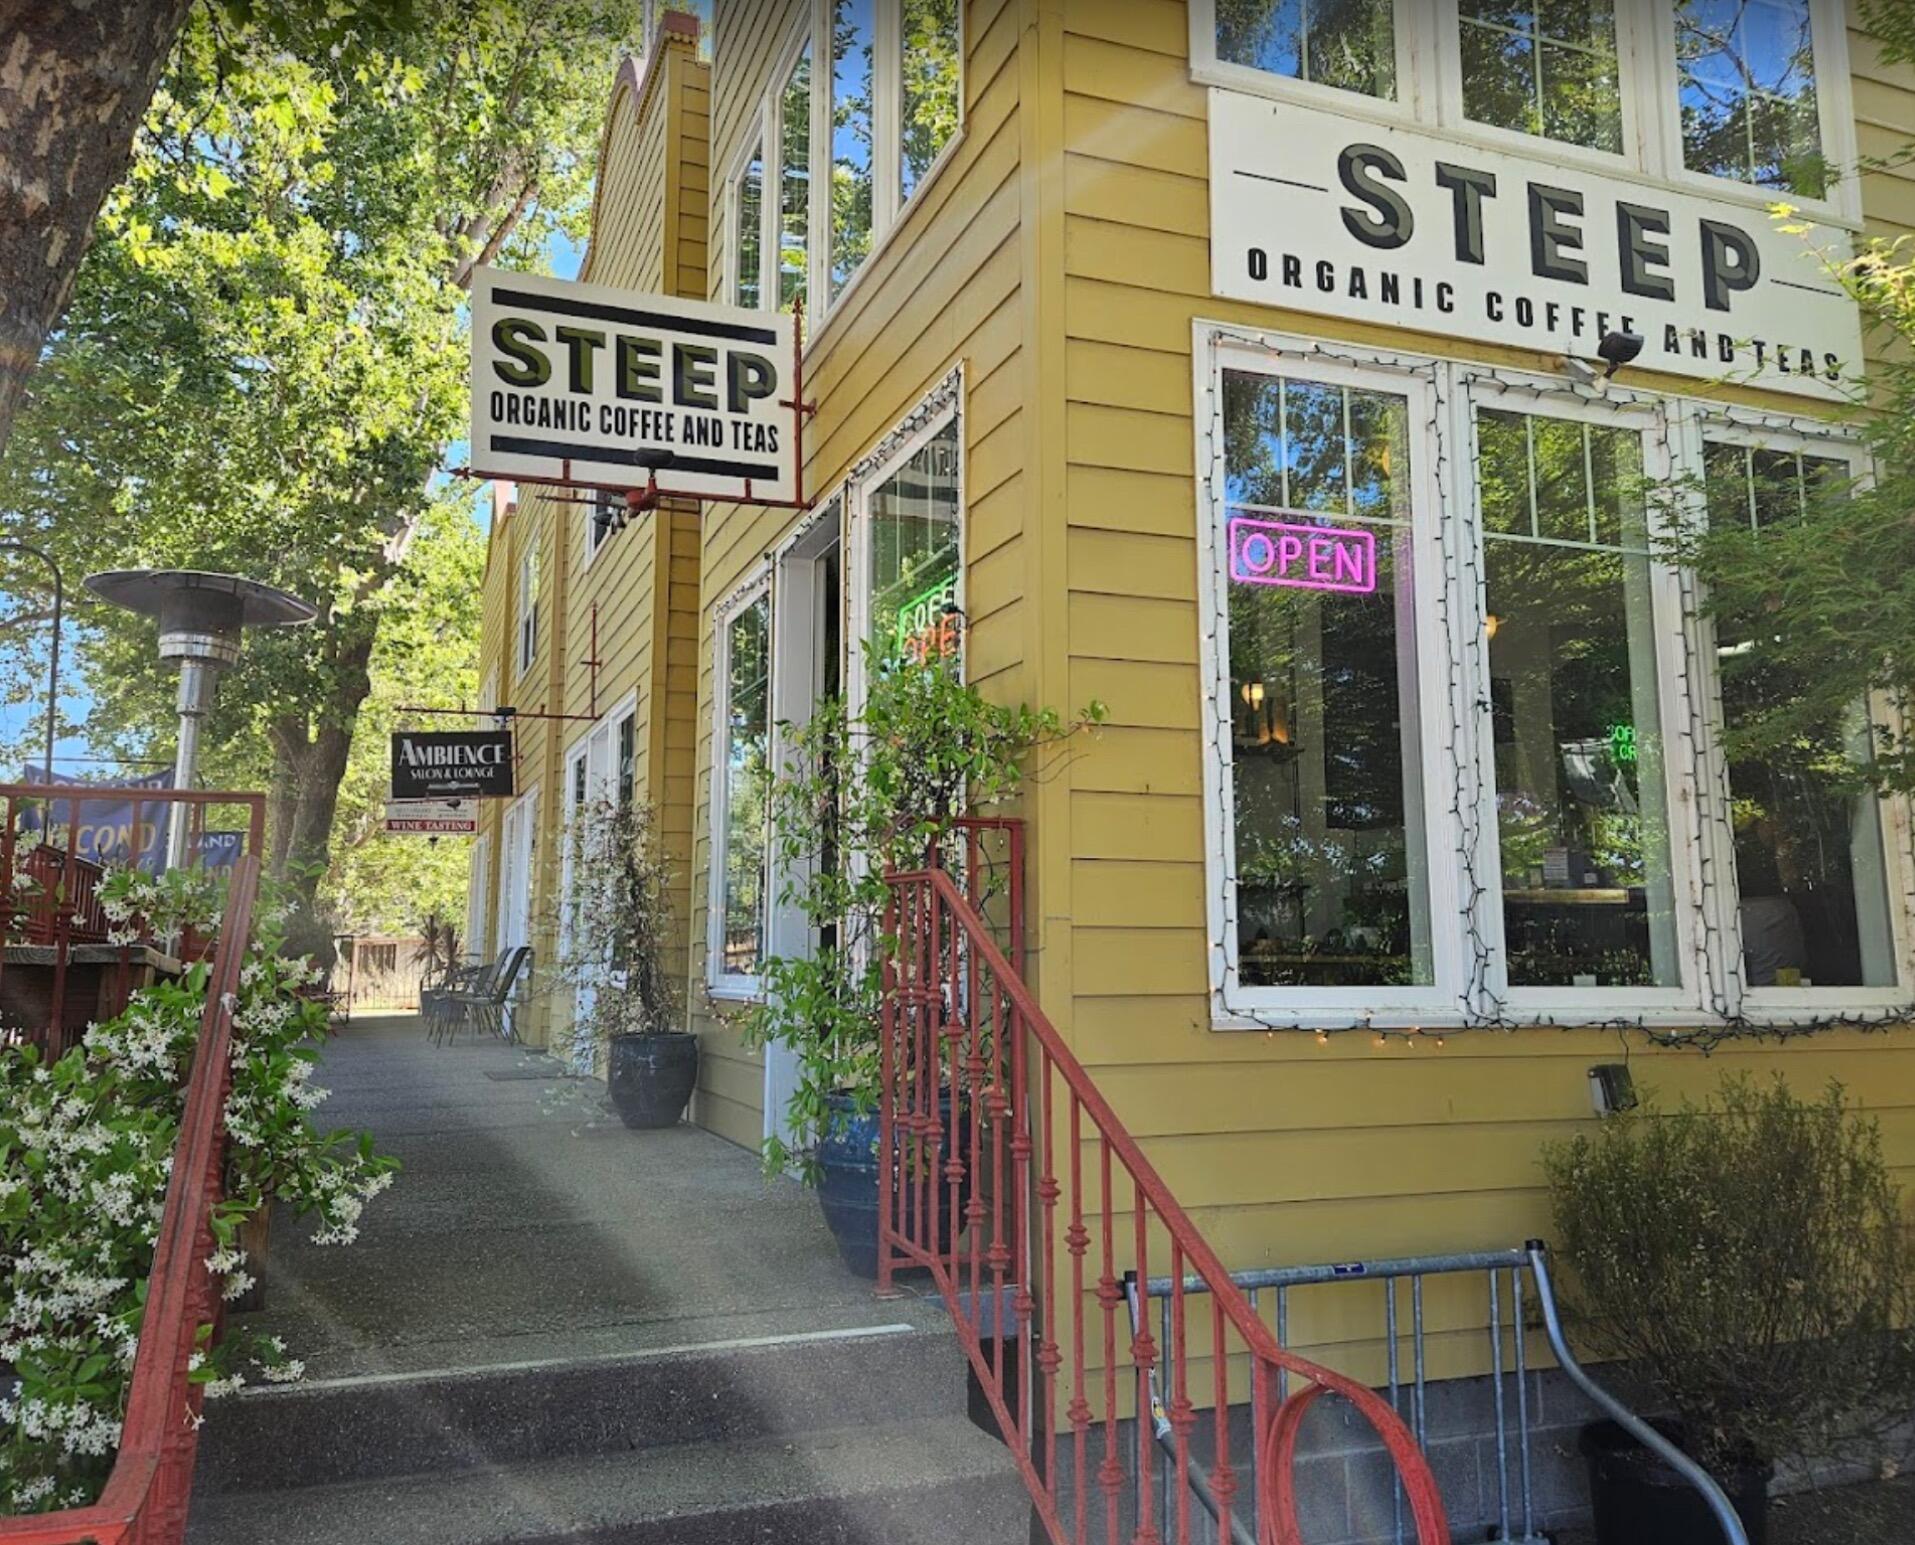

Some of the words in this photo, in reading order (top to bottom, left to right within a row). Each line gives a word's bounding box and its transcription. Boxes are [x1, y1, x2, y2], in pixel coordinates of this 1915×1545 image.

[1337, 143, 1761, 313] STEEP
[1248, 248, 1454, 313] ORGANIC
[1664, 324, 1735, 363] AND
[1752, 339, 1840, 381] TEAS
[492, 317, 778, 415] STEEP
[490, 391, 591, 433] ORGANIC
[600, 404, 674, 442] COFFEE
[683, 415, 723, 448] AND
[731, 421, 779, 453] TEAS
[1242, 533, 1363, 583] OPEN
[399, 739, 506, 767] AMBIENCE
[411, 767, 442, 780] SALON
[453, 766, 495, 779] LOUNGE
[391, 820, 421, 831] WINE
[425, 820, 472, 831] TASTING
